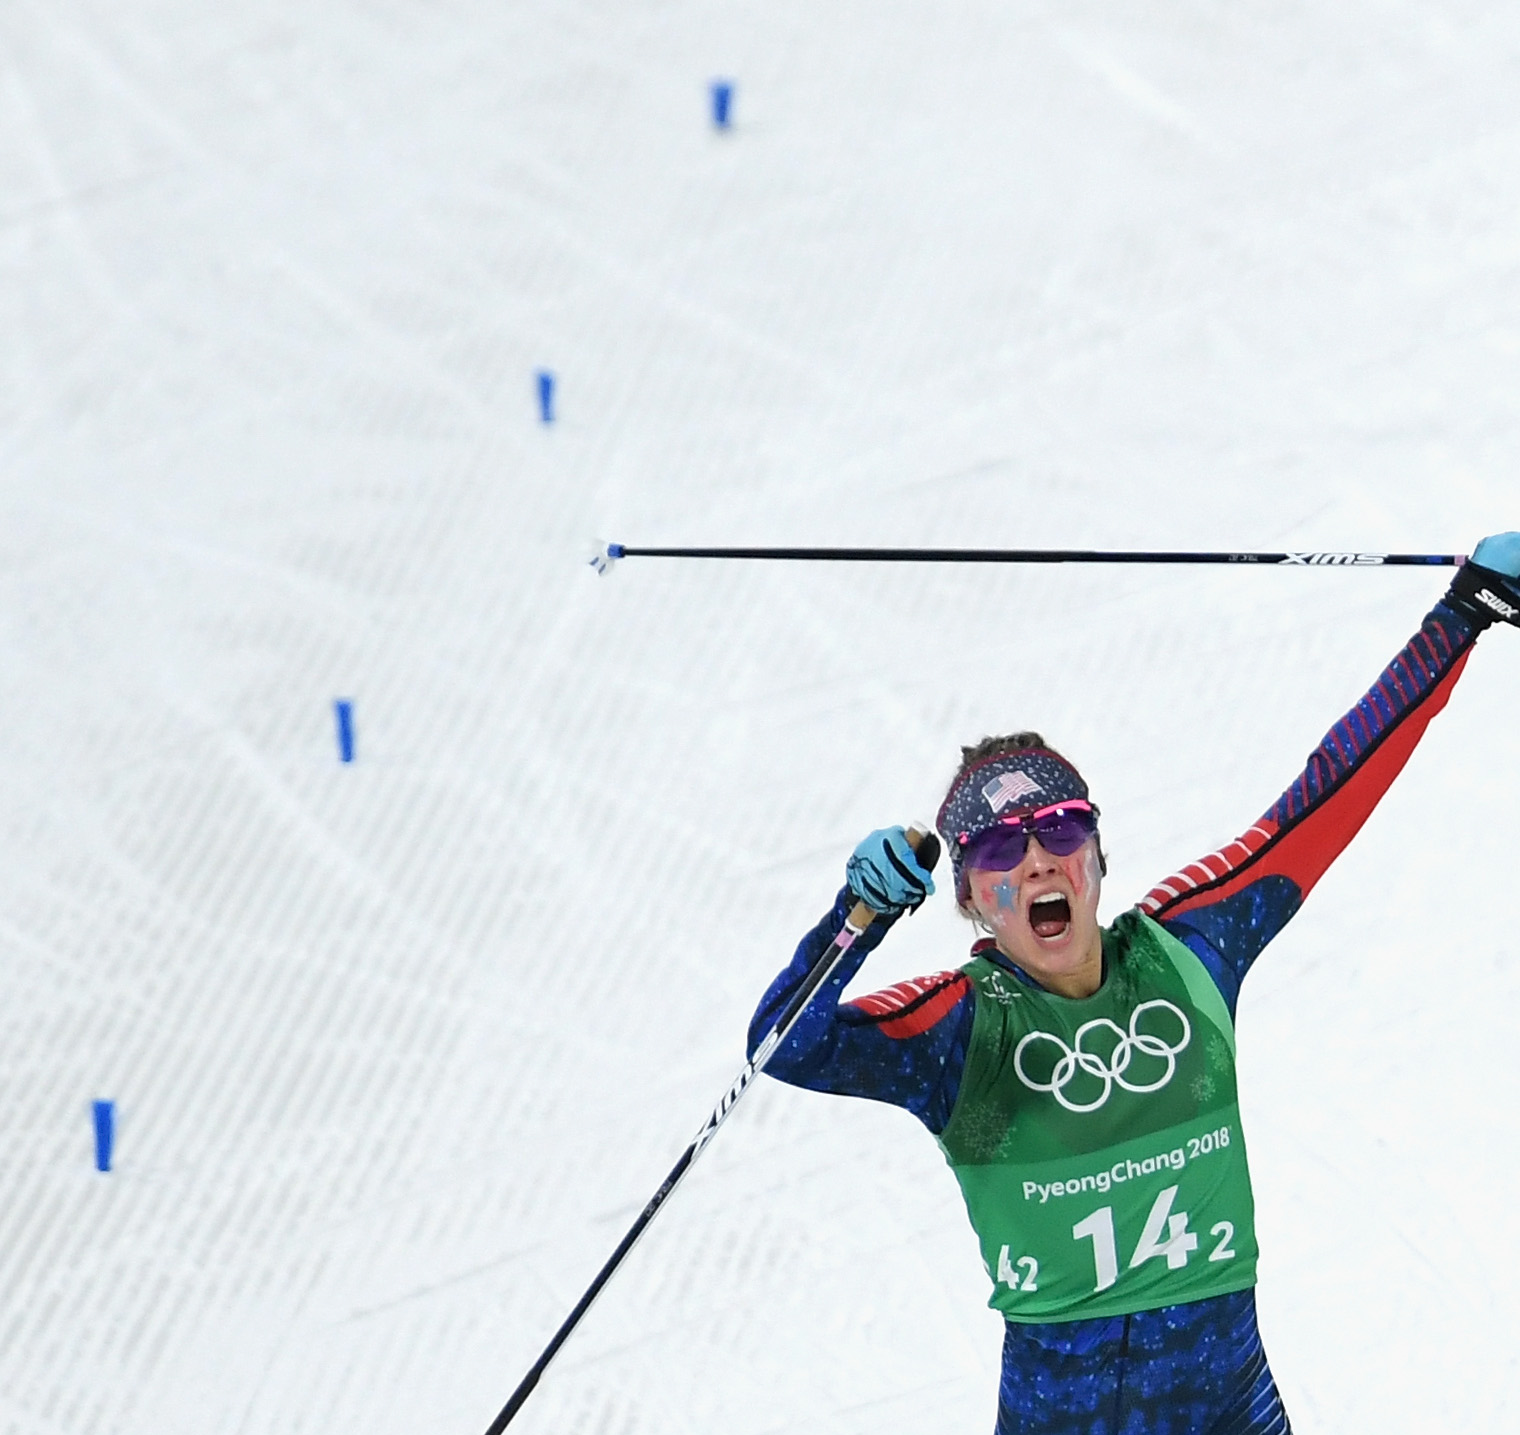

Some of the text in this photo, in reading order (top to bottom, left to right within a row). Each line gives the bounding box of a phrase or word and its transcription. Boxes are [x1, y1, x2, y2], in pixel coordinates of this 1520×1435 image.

[1022, 1126, 1231, 1203] PyeongChang 2018
[1072, 1185, 1236, 1293] 14 2
